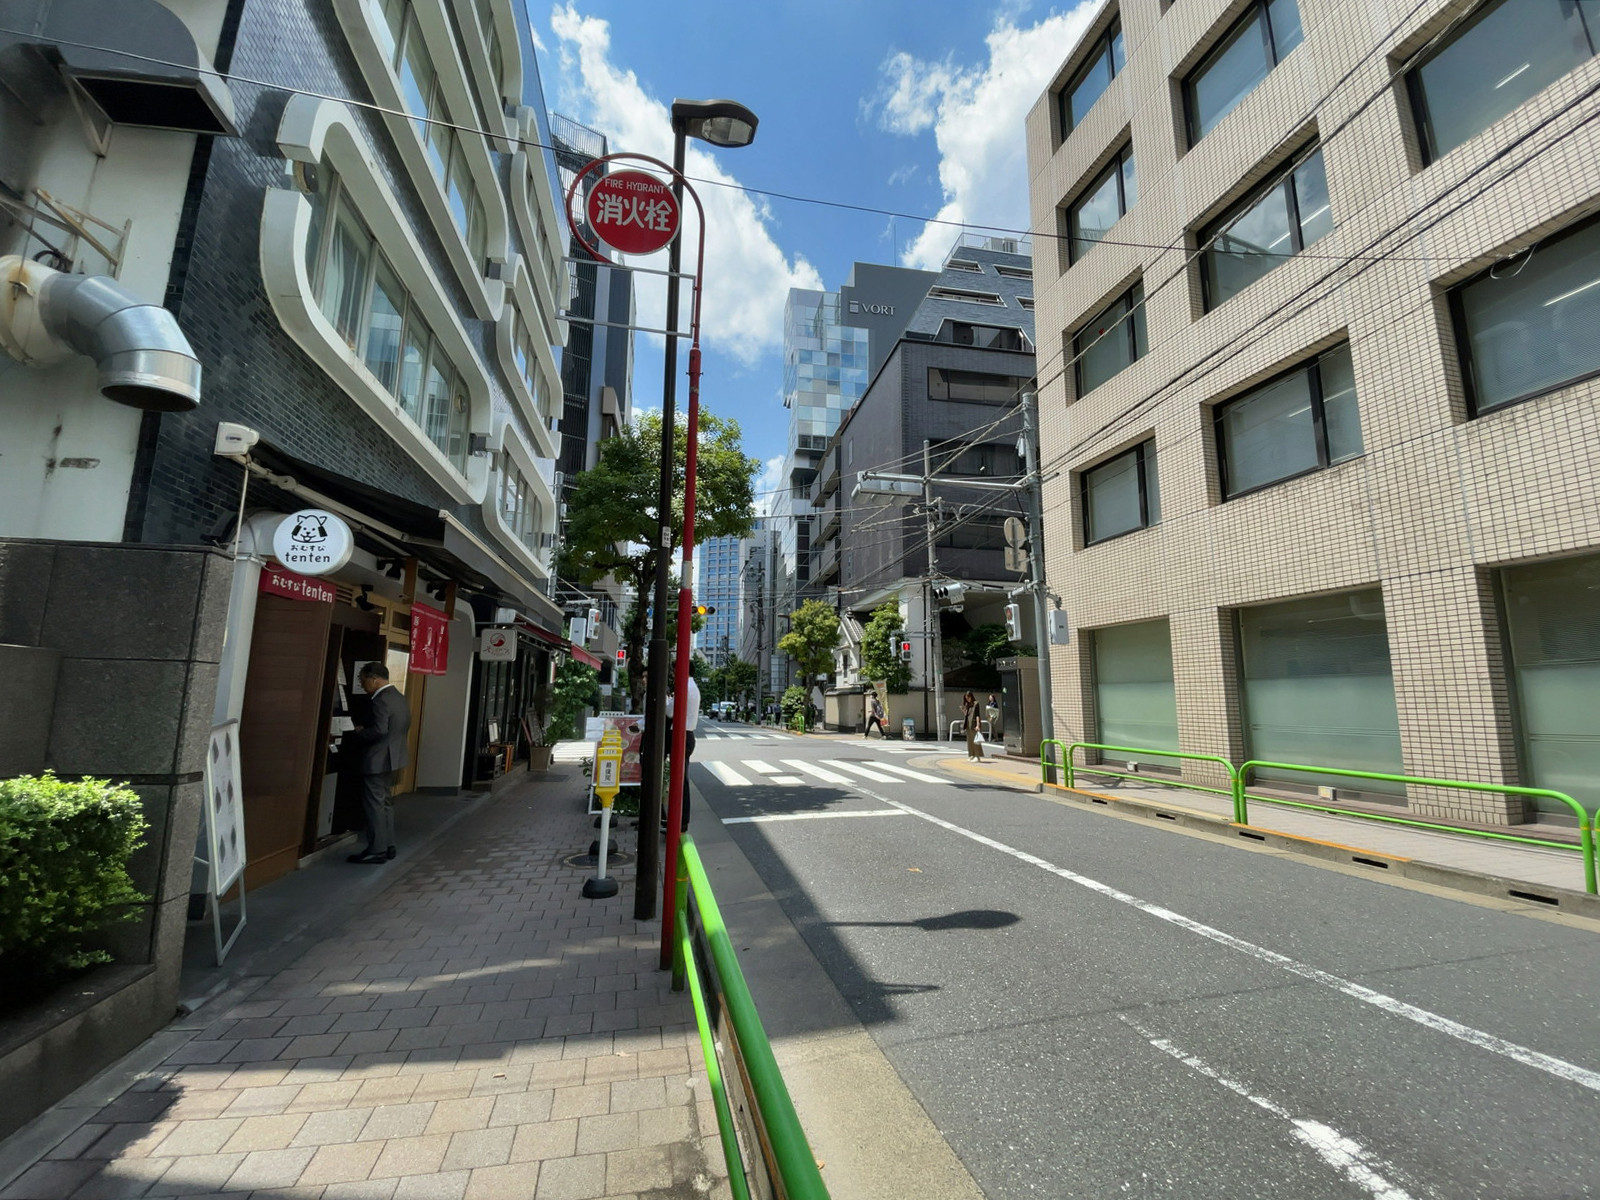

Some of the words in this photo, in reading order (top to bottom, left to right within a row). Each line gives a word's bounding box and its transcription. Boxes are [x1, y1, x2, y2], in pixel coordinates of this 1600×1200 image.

[605, 178, 624, 189] FIRE
[626, 181, 665, 194] HYDRANT
[597, 192, 672, 231] 消火栓
[862, 303, 894, 315] VORT
[285, 552, 331, 563] tenten
[272, 575, 301, 592] おむすび
[302, 580, 333, 603] tenten
